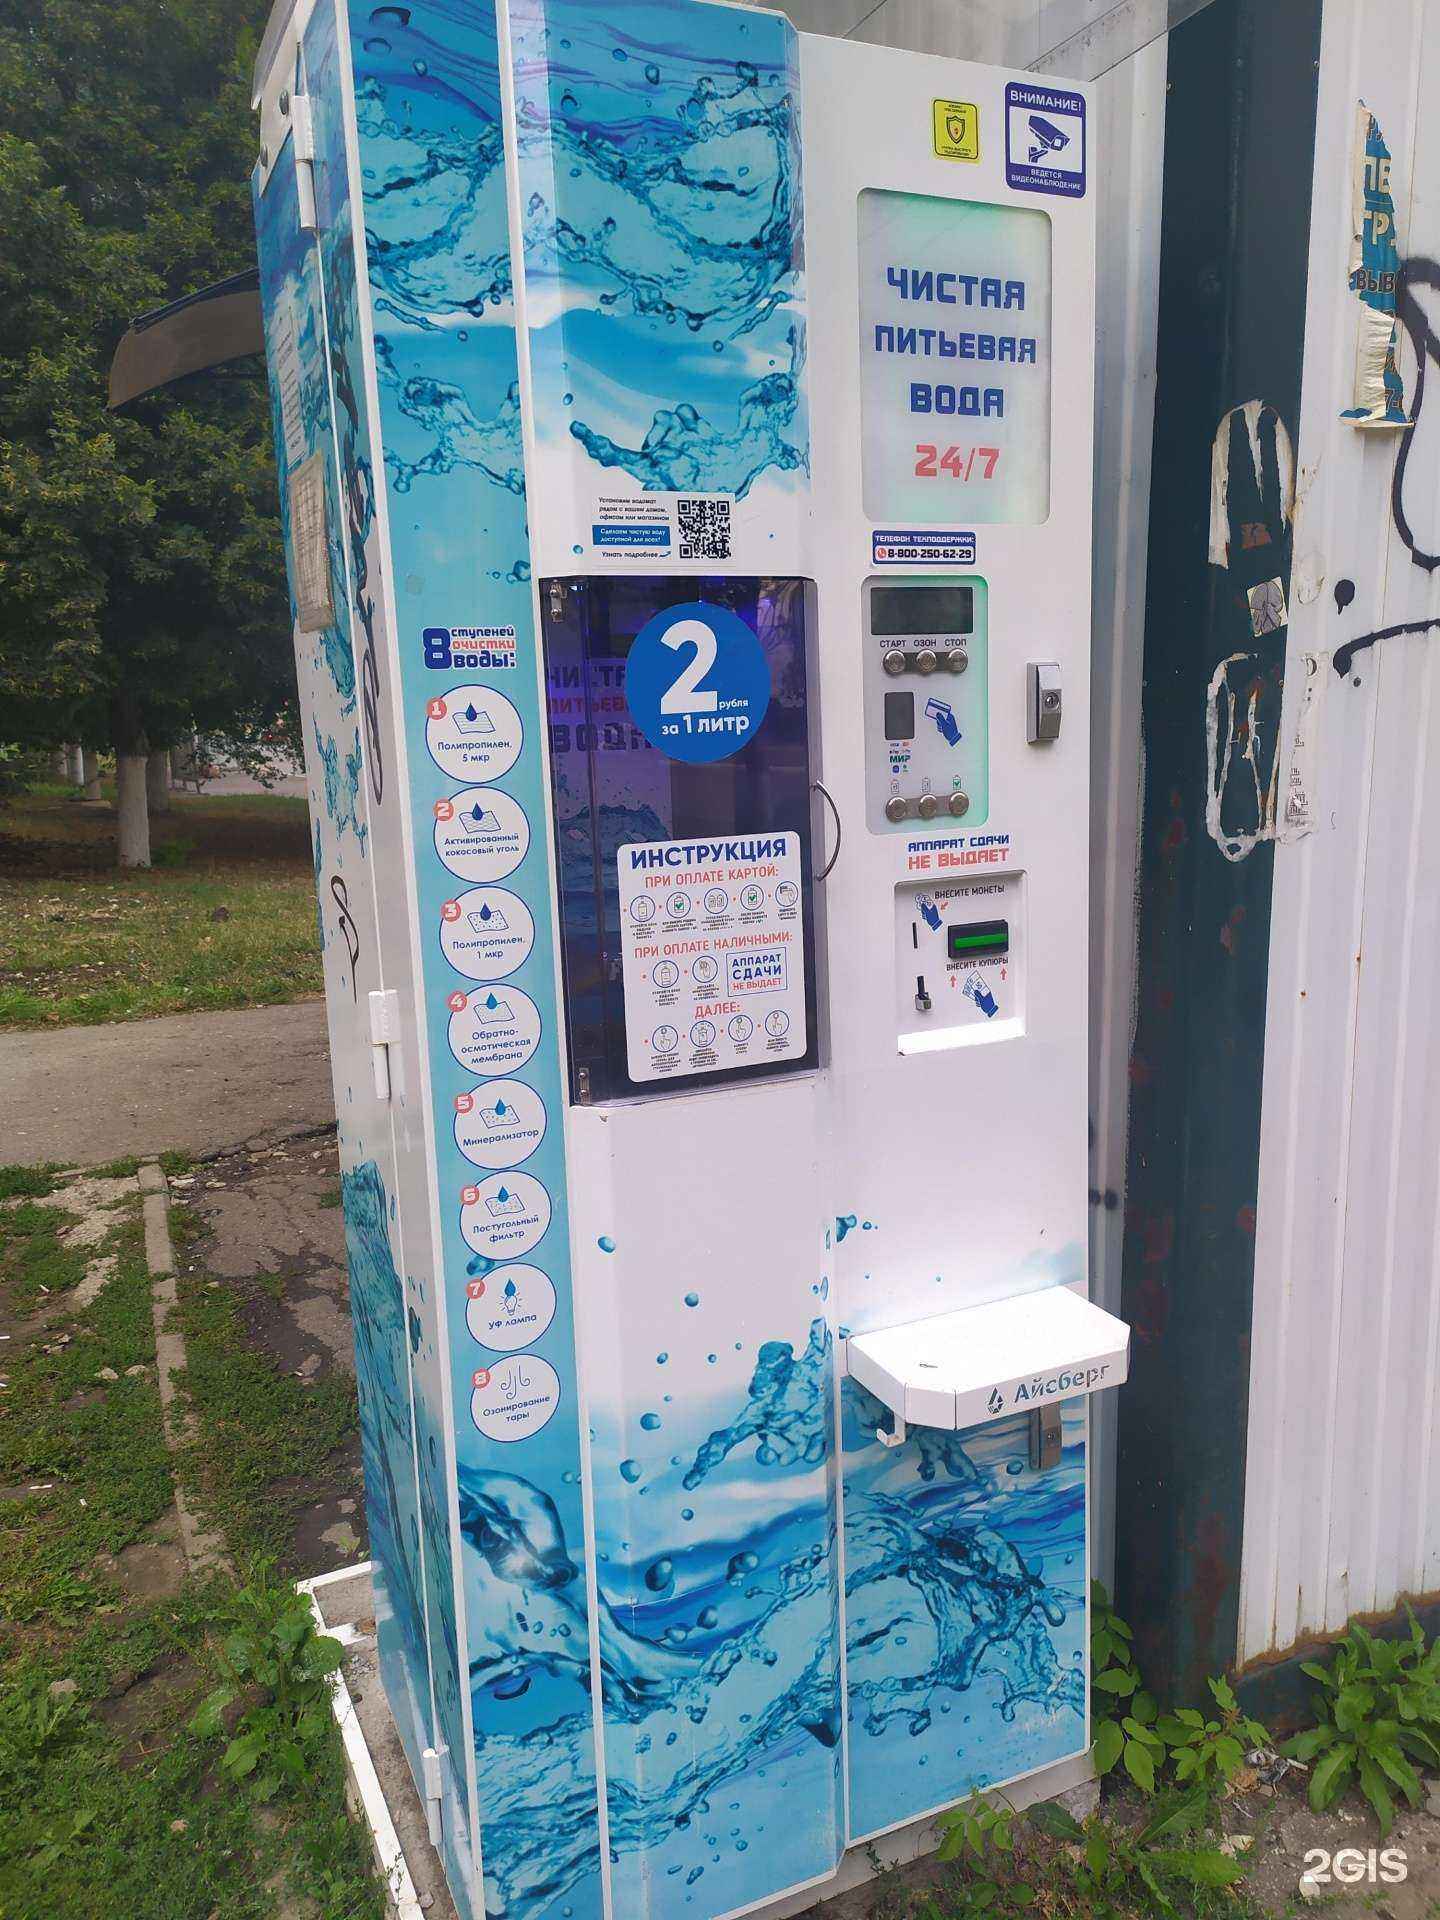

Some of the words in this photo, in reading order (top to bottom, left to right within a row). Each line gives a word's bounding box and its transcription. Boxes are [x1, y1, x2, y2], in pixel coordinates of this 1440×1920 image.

[1010, 90, 1081, 112] ВНИМАНИЕ!
[1030, 168, 1062, 179] ВЕДЕТСЯ
[1011, 174, 1081, 191] ВИДЕОНАБЛЮДЕНИЕ
[887, 266, 1026, 311] ЧИСТАЯ
[875, 324, 1036, 364] ПИТЬЕВАЯ
[910, 382, 1004, 418] ВОДА
[914, 444, 1000, 482] 24/7
[600, 528, 628, 536] Сделаем
[600, 536, 632, 544] доступной
[887, 548, 972, 559] 8-800-250-62-29
[423, 627, 453, 670] 8
[452, 626, 514, 639] ступеней
[452, 639, 515, 650] очистки
[880, 639, 906, 648] СТАРТ
[913, 639, 937, 647] ОЗОН
[944, 638, 967, 647] СТОП
[453, 650, 516, 668] воды:
[660, 619, 718, 715] 2
[719, 698, 749, 711] рубля
[431, 701, 442, 716] 1
[661, 723, 679, 736] за
[683, 715, 693, 734] 1
[697, 714, 750, 736] литр
[462, 754, 468, 763] 5
[470, 755, 490, 764] мкр
[889, 755, 912, 763] МИР
[436, 802, 449, 818] 2
[444, 833, 519, 847] Активированный
[908, 838, 965, 852] АППАРАТ
[970, 834, 1010, 847] СДАЧИ
[445, 847, 494, 858] кокосовый
[496, 846, 520, 855] уголь
[631, 838, 787, 870] ИНСТРУКЦИЯ
[908, 854, 931, 871] НЕ
[937, 848, 1010, 868] ВЫДАЕТ
[645, 875, 672, 889] ПРИ
[675, 869, 724, 886] ОПЛАТЕ
[728, 864, 779, 881] КАРТОЙ:
[934, 887, 970, 900] ВНЕСИТЕ
[971, 884, 1005, 896] МОНЕТЫ
[444, 903, 457, 919] 3
[634, 945, 659, 959] ПРИ
[663, 940, 709, 956] ОПЛАТЕ
[713, 931, 793, 950] НАЛИЧНЫМИ:
[477, 951, 482, 960] 1
[484, 951, 504, 960] мкр
[731, 953, 782, 968] АППАРАТ
[946, 960, 977, 972] ВНЕСИТЕ
[978, 957, 1009, 968] КУПЮРЫ
[732, 965, 782, 981] СДАЧИ
[732, 980, 745, 991] НЕ
[745, 977, 782, 990] ВЫДАЕТ
[450, 994, 464, 1008] 4
[694, 1001, 741, 1020] ДАЛЕЕ:
[471, 1029, 519, 1042] Обратно-
[461, 1038, 531, 1054] осмотическая
[470, 1051, 523, 1065] мембрана
[457, 1096, 470, 1110] 5
[462, 1129, 539, 1147] Минерализатор
[472, 1215, 539, 1234] Постугольный
[489, 1229, 525, 1244] фильтр
[469, 1282, 482, 1297] 7
[504, 1313, 538, 1328] лампа
[1014, 1364, 1111, 1404] Айсберг
[482, 1394, 551, 1418] Озонирование
[505, 1411, 530, 1424] тары
